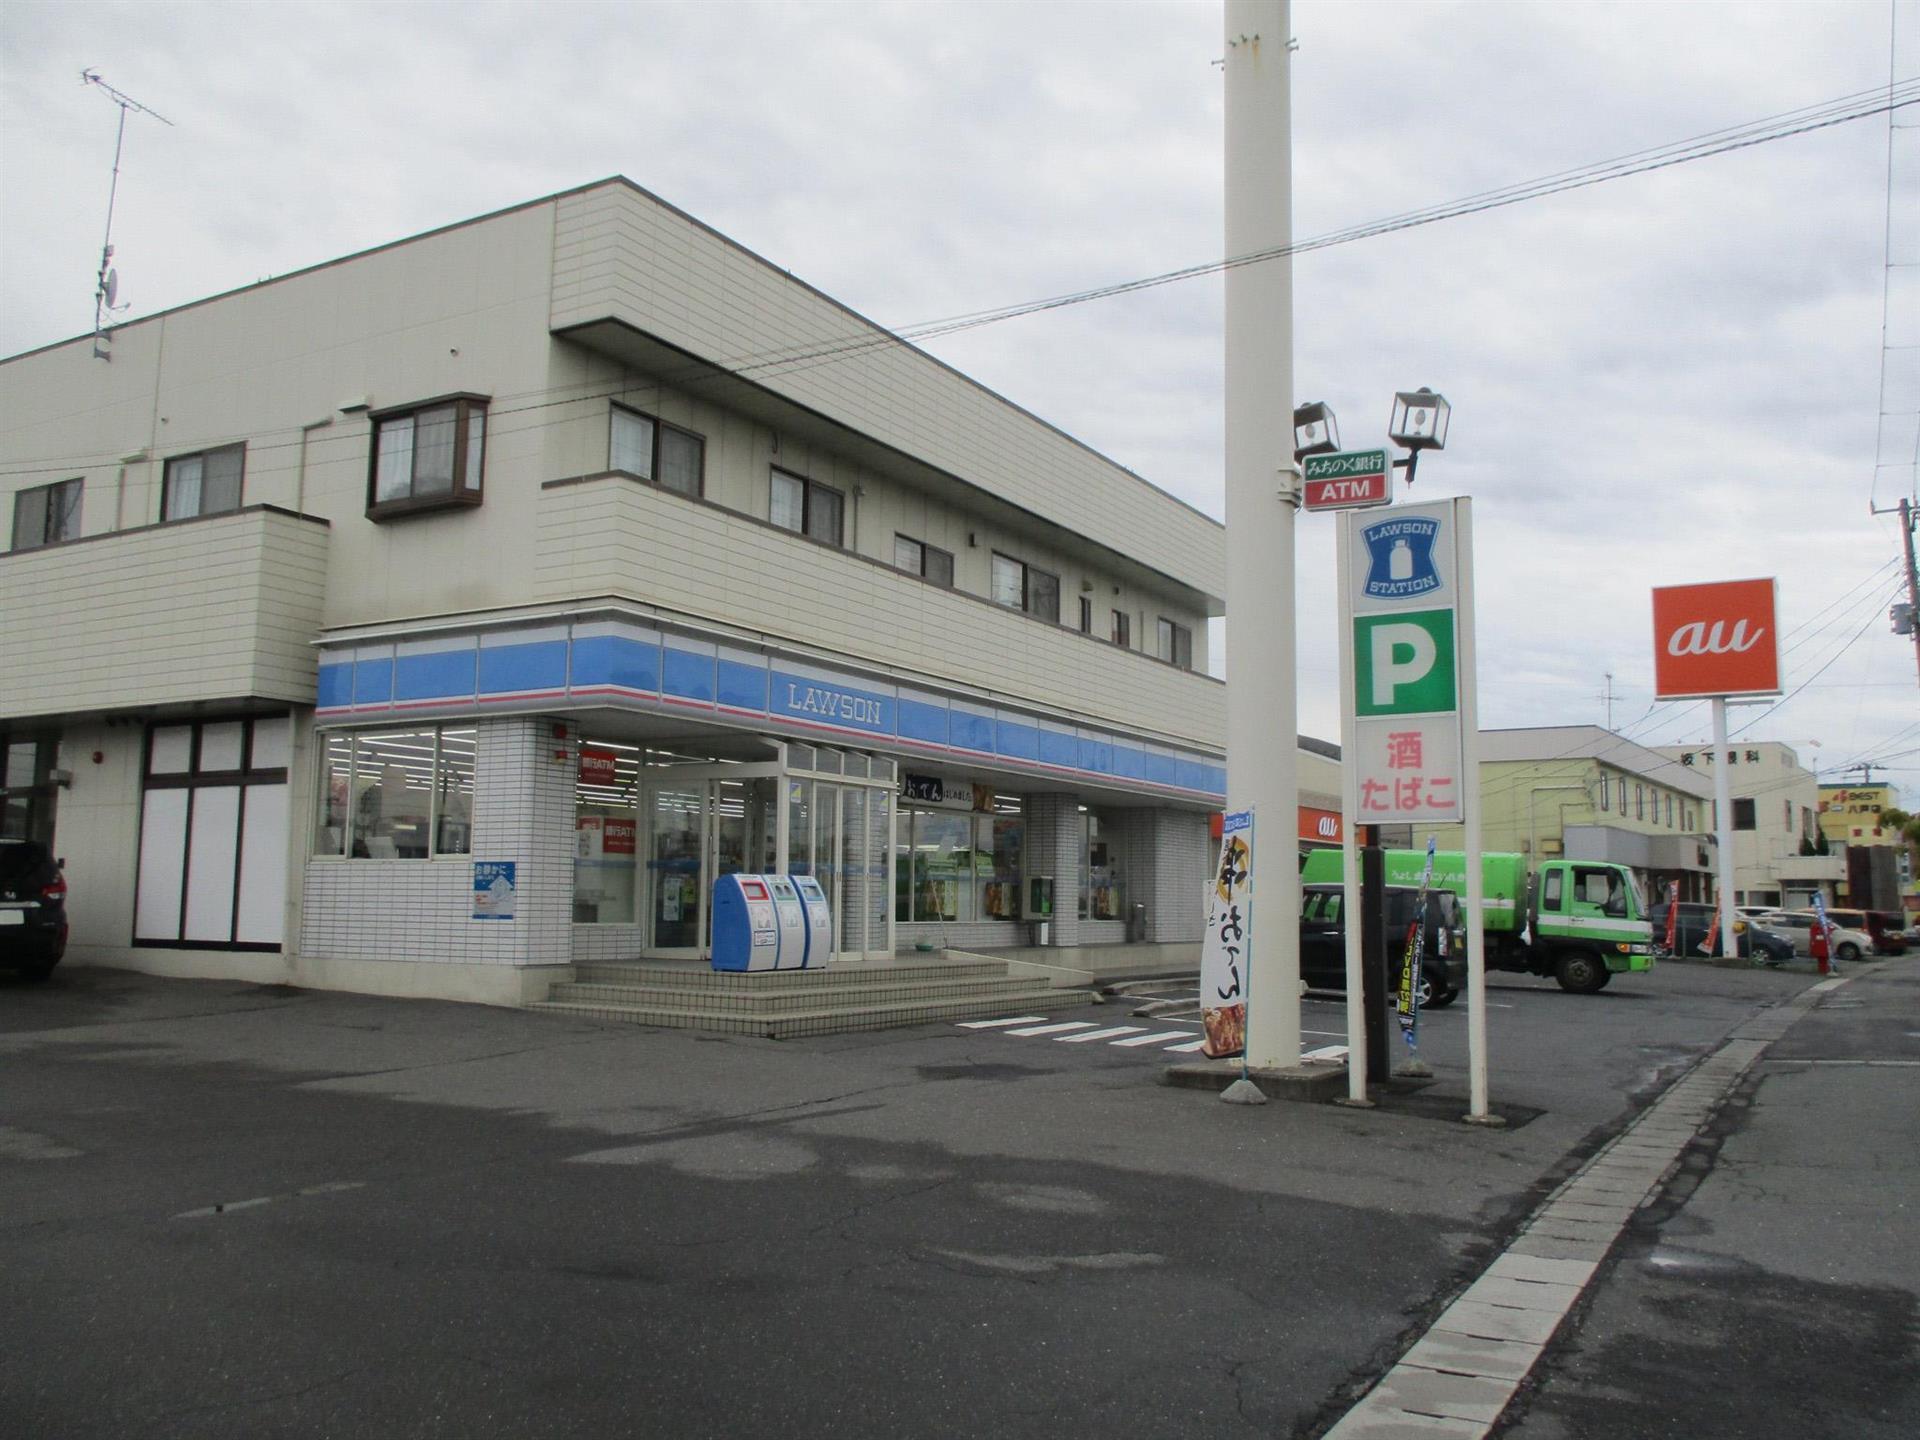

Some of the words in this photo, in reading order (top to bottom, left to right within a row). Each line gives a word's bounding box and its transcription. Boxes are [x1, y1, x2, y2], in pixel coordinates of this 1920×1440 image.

[1307, 453, 1384, 475] みちのく銀行
[1320, 479, 1370, 501] ATM
[1368, 522, 1433, 542] LAWSON
[1369, 575, 1436, 594] STATION
[1667, 618, 1764, 657] au
[1371, 623, 1437, 706] P
[787, 682, 882, 725] LAWSON
[1387, 731, 1423, 769] 酒
[907, 779, 942, 801] おでん
[1360, 777, 1456, 811] たばこ
